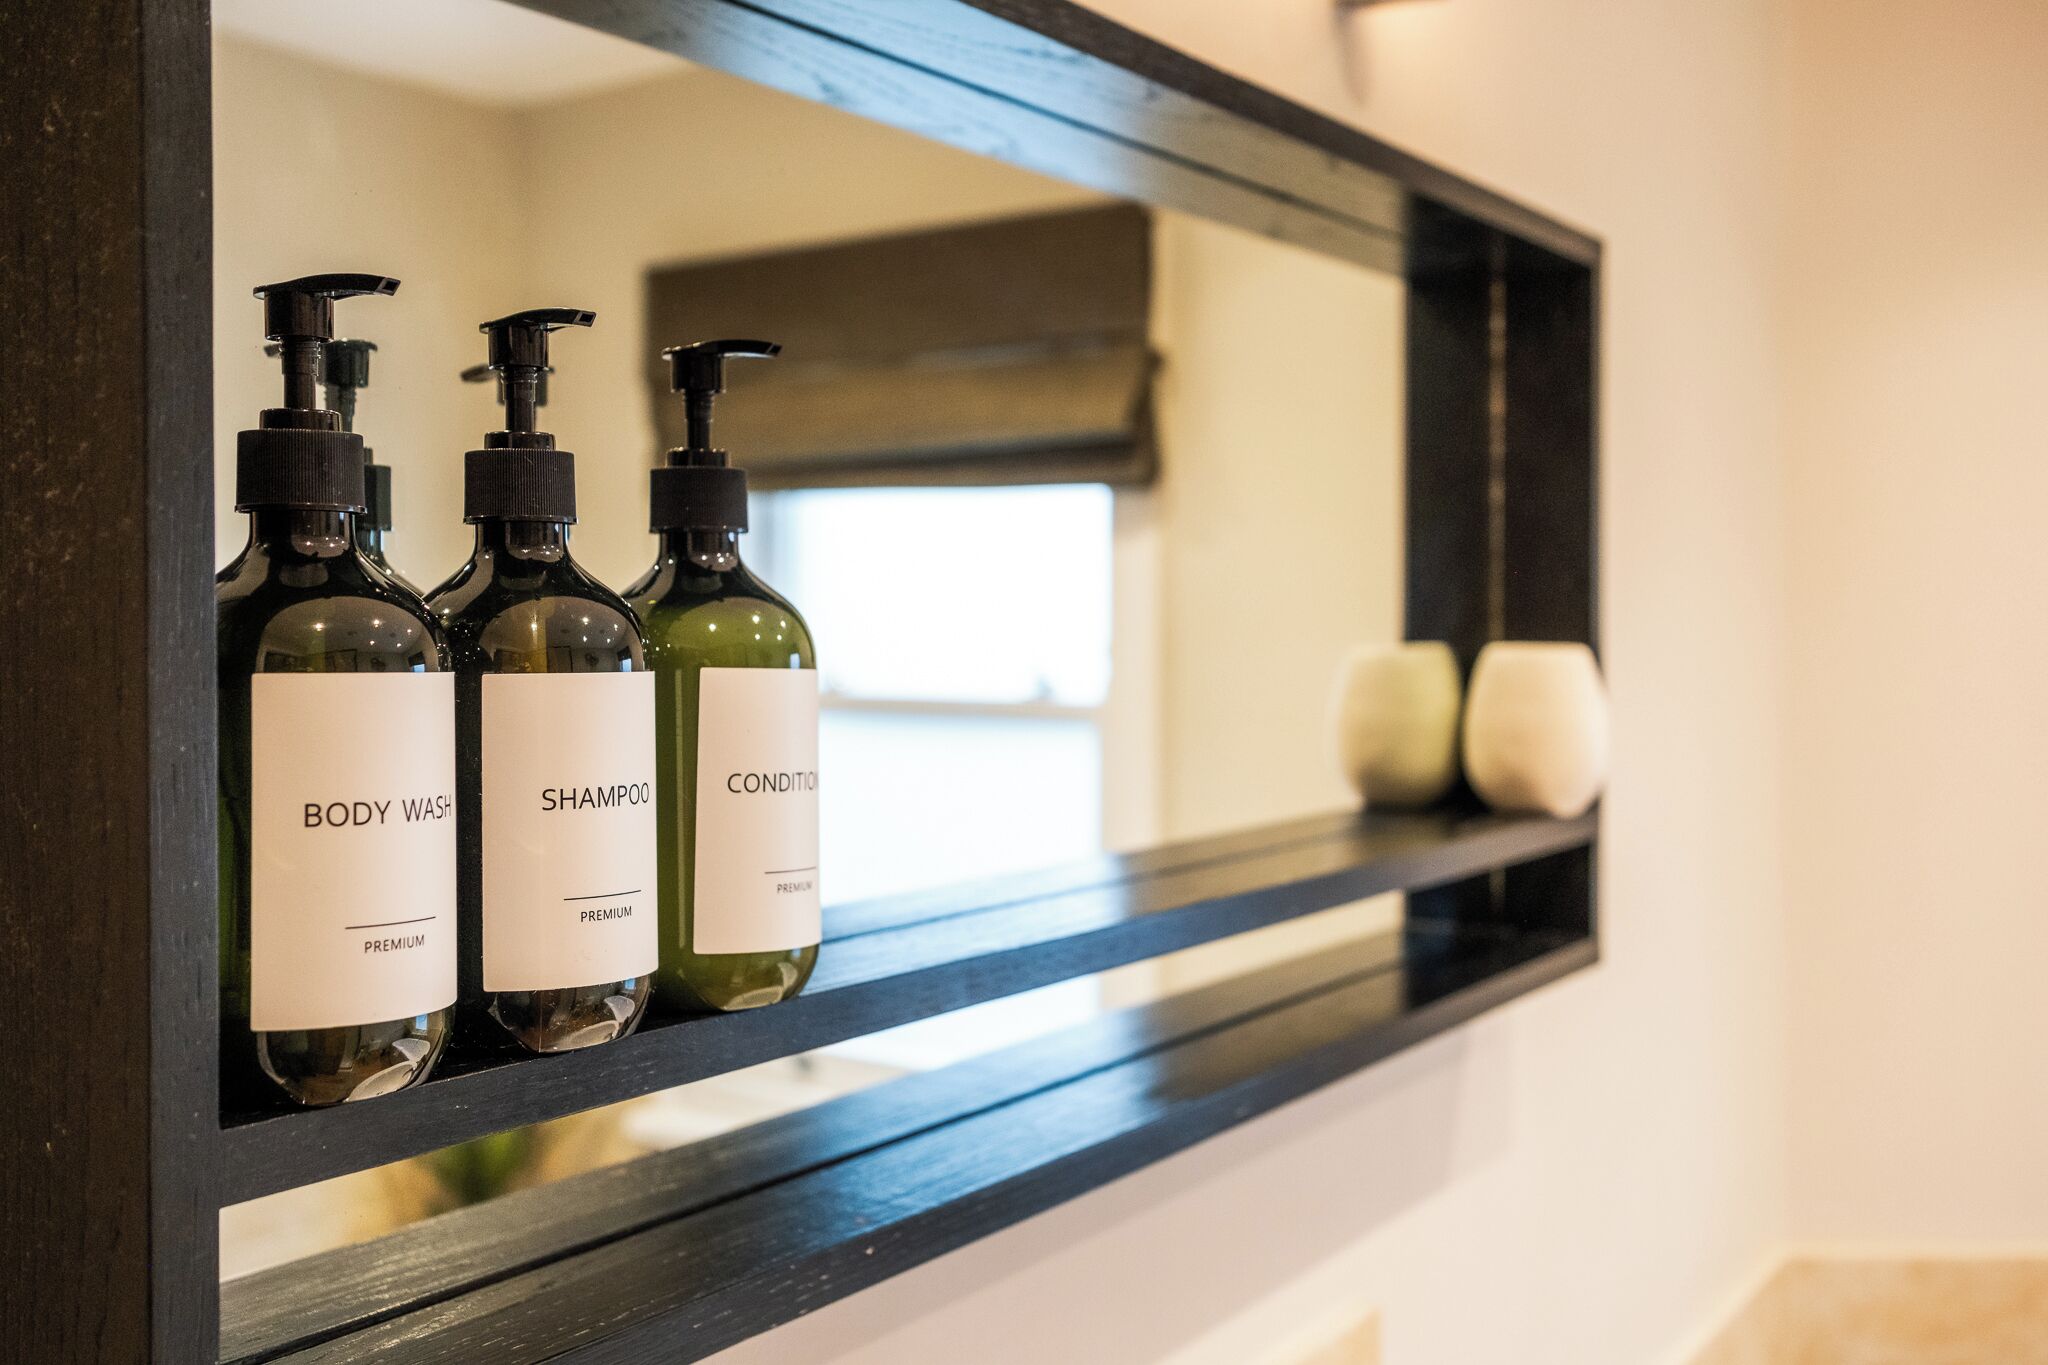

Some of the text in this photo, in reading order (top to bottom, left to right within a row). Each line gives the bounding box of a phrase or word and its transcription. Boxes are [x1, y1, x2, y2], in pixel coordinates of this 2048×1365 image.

[542, 782, 649, 811] SHAMPOO
[304, 794, 452, 828] BODY WASH
[776, 880, 813, 894] PREMIUM
[580, 906, 632, 922] PREMIUM
[364, 934, 425, 954] PREMIUM
